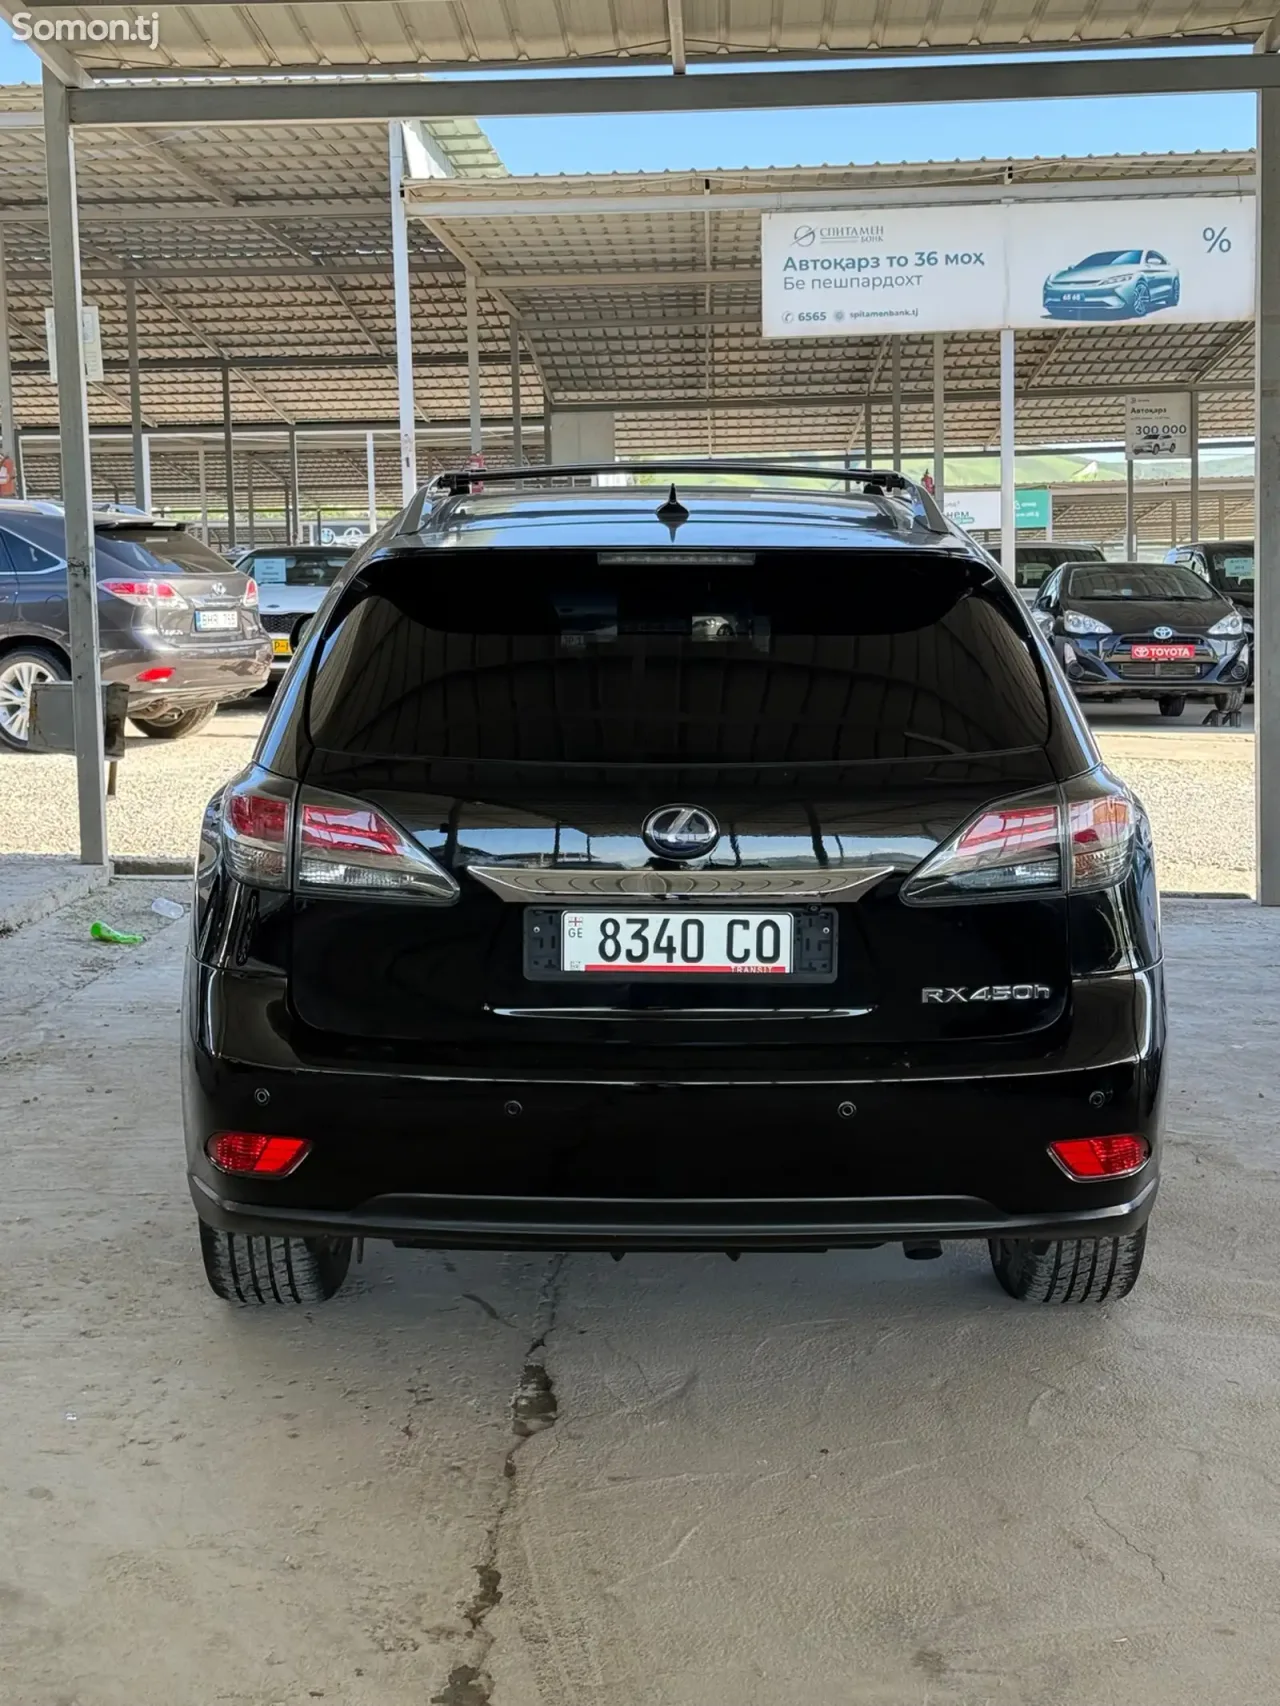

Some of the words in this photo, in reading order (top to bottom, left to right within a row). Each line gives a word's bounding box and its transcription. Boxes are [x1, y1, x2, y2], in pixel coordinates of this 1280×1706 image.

[820, 226, 884, 237] СПИТАМЕН
[1202, 226, 1232, 254] %
[783, 256, 880, 272] Автоқарз
[886, 255, 909, 268] то
[914, 251, 938, 267] 36
[944, 252, 985, 266] моҳ
[783, 276, 805, 290] Бе
[811, 274, 923, 291] пешпардохт
[798, 311, 827, 322] 6565
[849, 308, 919, 319] spitamenbank.tj
[1135, 425, 1159, 435] 300
[1161, 424, 1187, 434] 000
[1150, 647, 1190, 657] TOYOTA
[568, 927, 583, 938] GE
[598, 917, 705, 963] 8340
[726, 919, 781, 964] CO
[730, 965, 773, 974] TRANSIT
